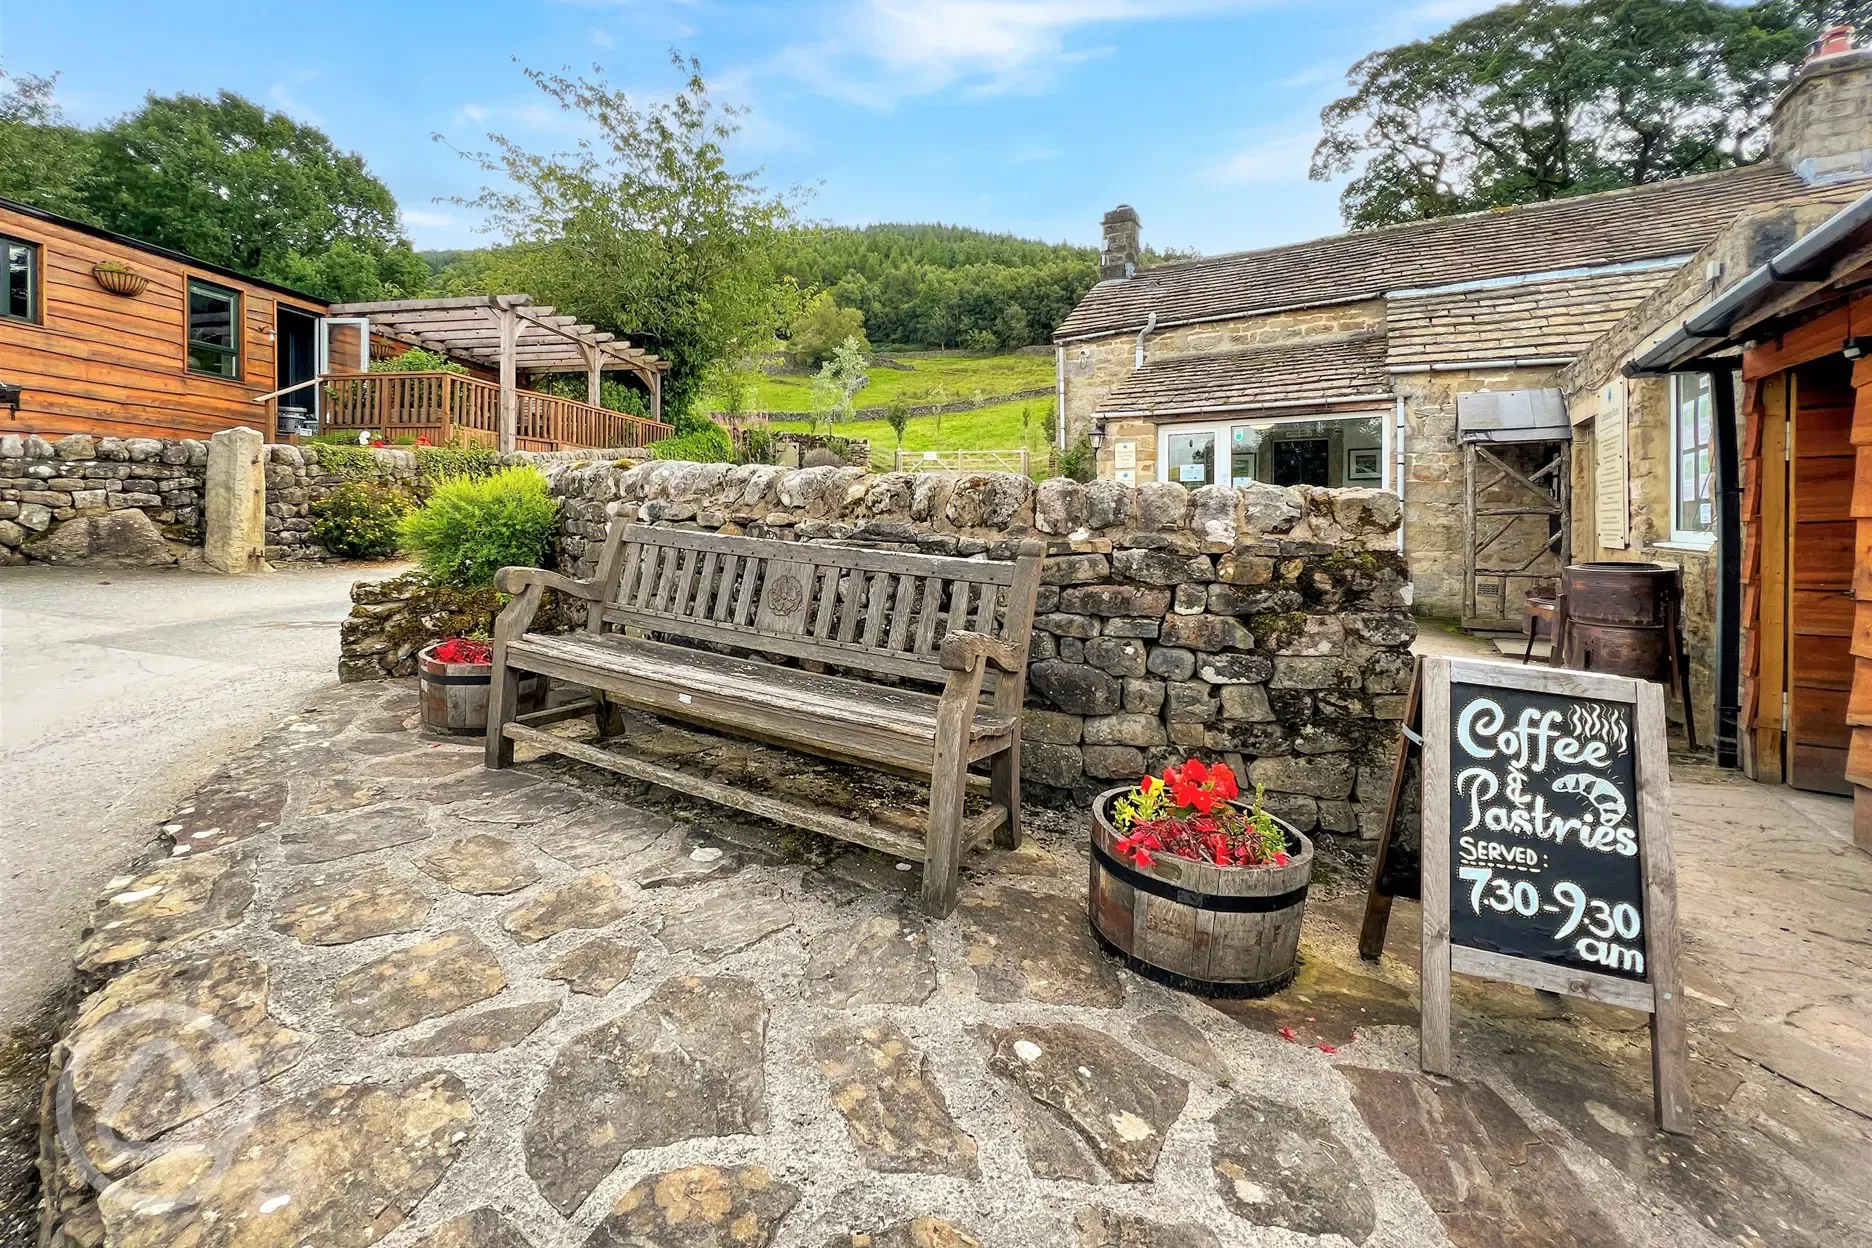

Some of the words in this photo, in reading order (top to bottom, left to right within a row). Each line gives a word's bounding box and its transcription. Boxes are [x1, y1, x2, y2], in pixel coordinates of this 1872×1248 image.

[1457, 698, 1612, 772] Coffee
[1456, 768, 1638, 856] Pastries
[1507, 767, 1531, 807] &
[1575, 938, 1644, 973] am
